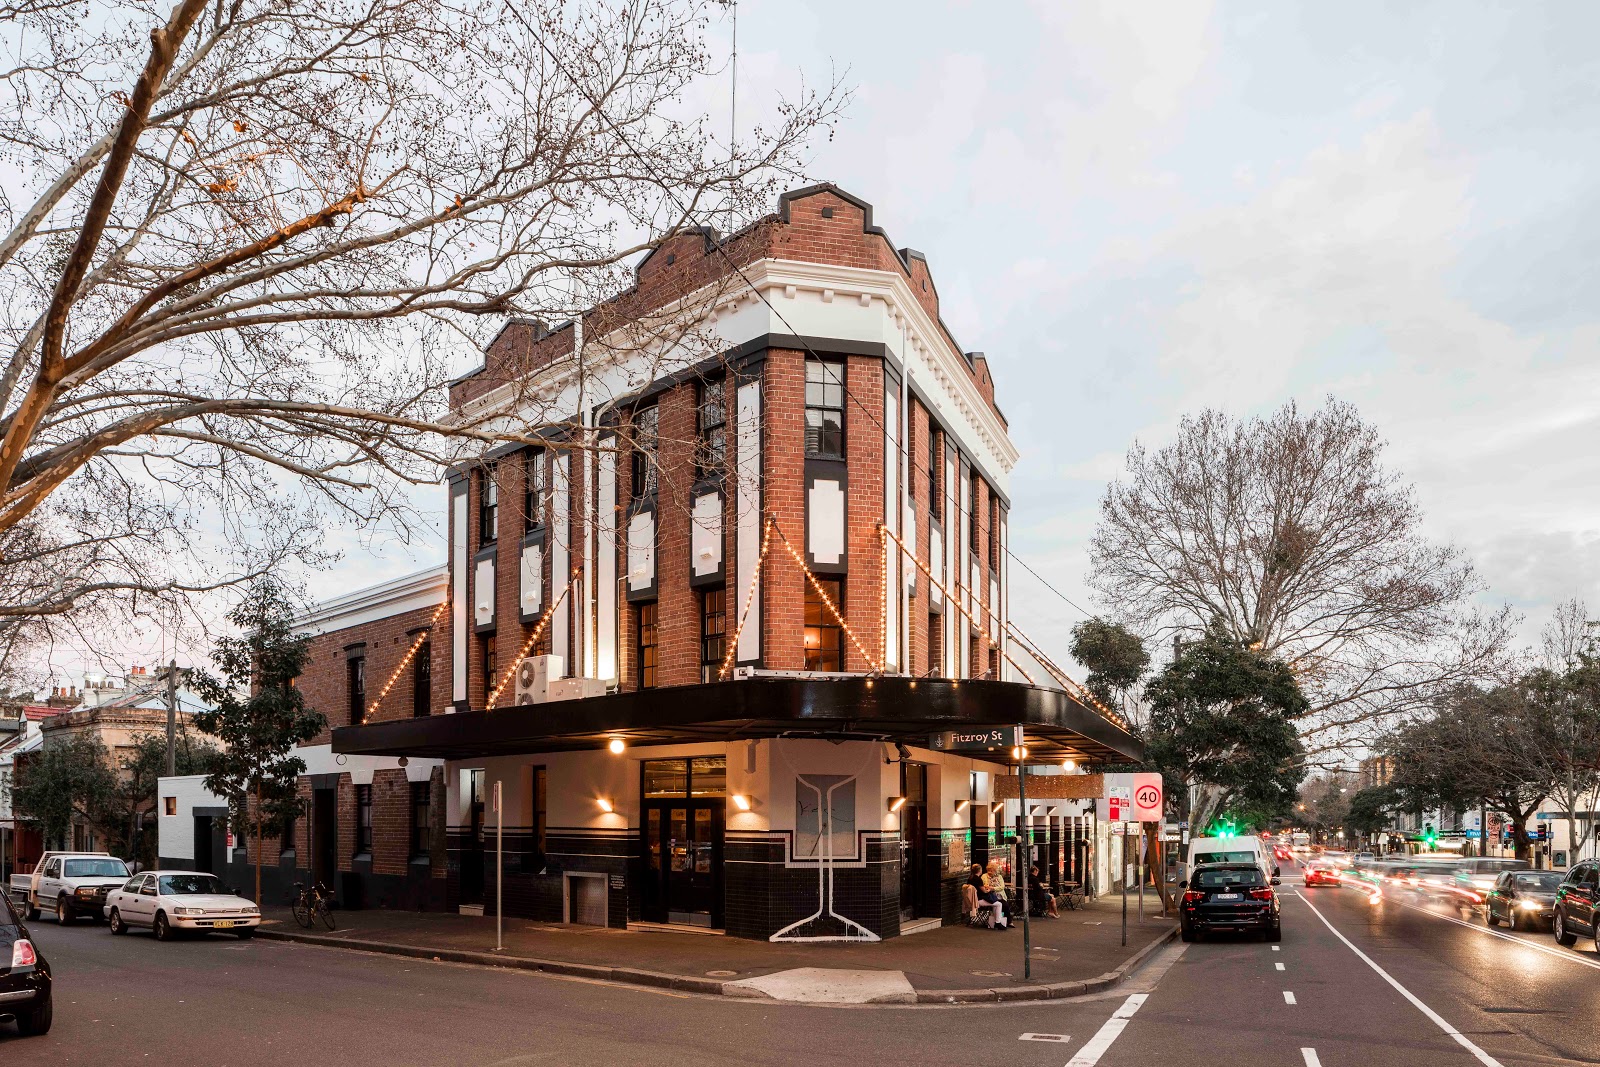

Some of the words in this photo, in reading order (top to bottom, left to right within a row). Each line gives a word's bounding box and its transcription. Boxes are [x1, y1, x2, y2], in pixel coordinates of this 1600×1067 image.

[951, 732, 989, 744] Fitzroy
[991, 730, 1003, 740] St
[1140, 792, 1157, 803] 40
